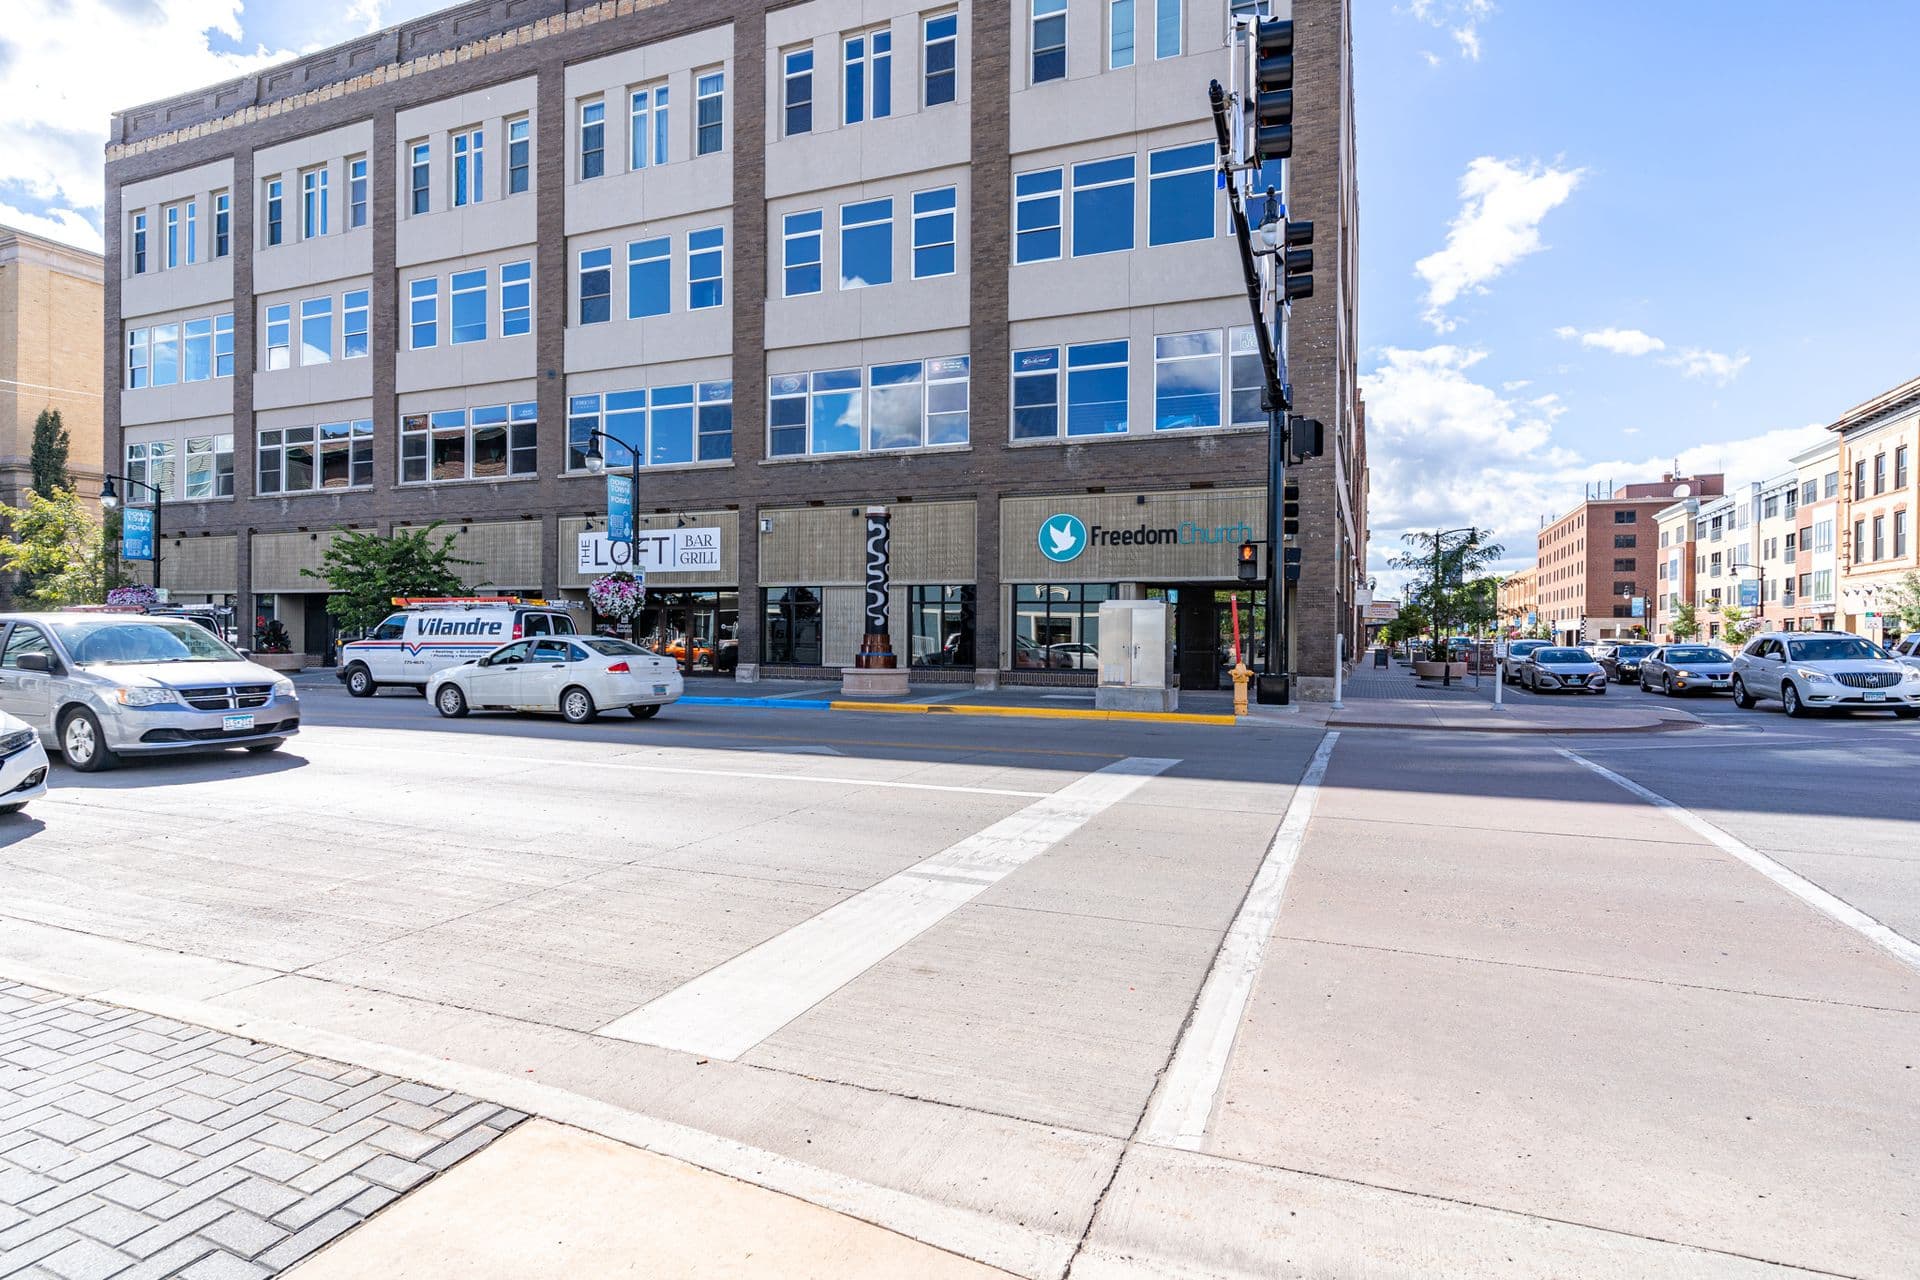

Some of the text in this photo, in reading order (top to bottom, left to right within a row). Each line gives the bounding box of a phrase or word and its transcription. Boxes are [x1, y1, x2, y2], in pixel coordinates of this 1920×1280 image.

[685, 534, 713, 547] BAR
[581, 539, 591, 566] THE
[680, 551, 717, 565] GRILL
[418, 617, 503, 636] Vilandre
